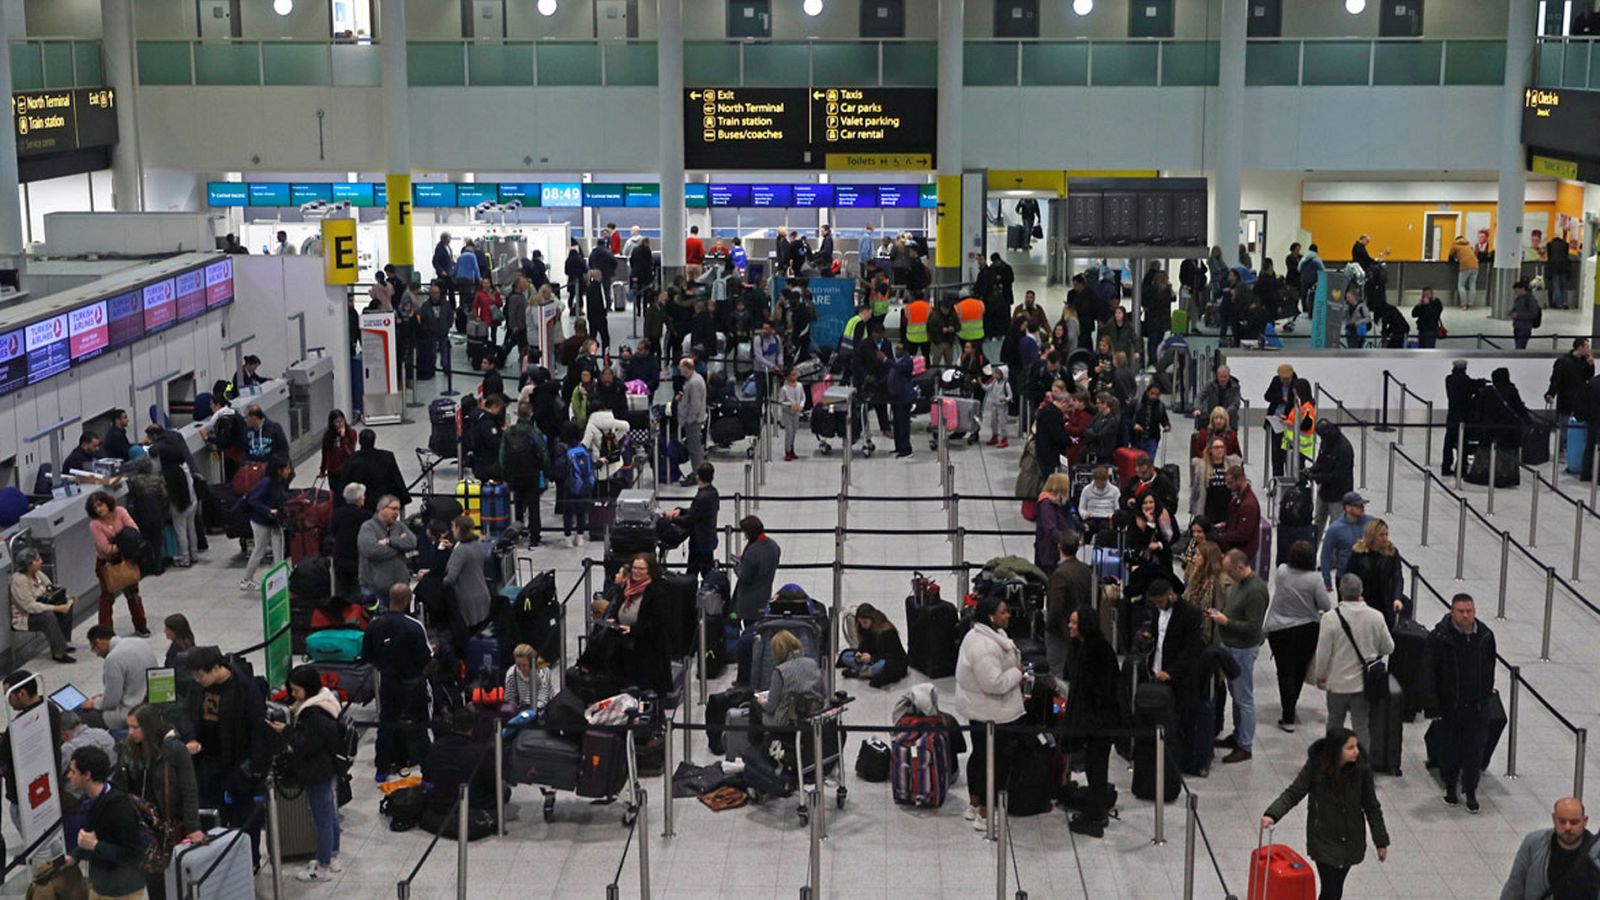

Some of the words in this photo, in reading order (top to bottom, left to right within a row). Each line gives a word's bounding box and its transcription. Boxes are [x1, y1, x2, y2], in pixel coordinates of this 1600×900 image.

[27, 95, 45, 109] North
[45, 93, 70, 108] Terminal
[89, 92, 99, 105] Exit
[718, 90, 734, 100] Exit
[841, 90, 863, 100] Taxis
[1538, 90, 1559, 106] Check-in
[718, 102, 744, 113] North
[746, 102, 784, 113] Terminal
[841, 103, 856, 113] Car
[858, 103, 882, 115] parks
[28, 115, 44, 130] Train
[44, 114, 65, 128] station
[718, 116, 740, 126] Train
[742, 116, 773, 126] station
[841, 116, 863, 126] Valet
[866, 116, 900, 128] parking
[718, 129, 783, 140] Buses/coaches
[841, 130, 856, 140] Car
[858, 129, 884, 140] rental
[847, 156, 876, 166] Toilets
[542, 187, 580, 200] 08:49
[399, 201, 410, 225] F
[335, 236, 354, 269] E
[811, 295, 831, 305] ARE
[73, 307, 94, 320] TURKISH
[31, 322, 52, 335] TURKISH
[73, 317, 95, 332] AIRLINES
[31, 331, 54, 345] AIRLINES
